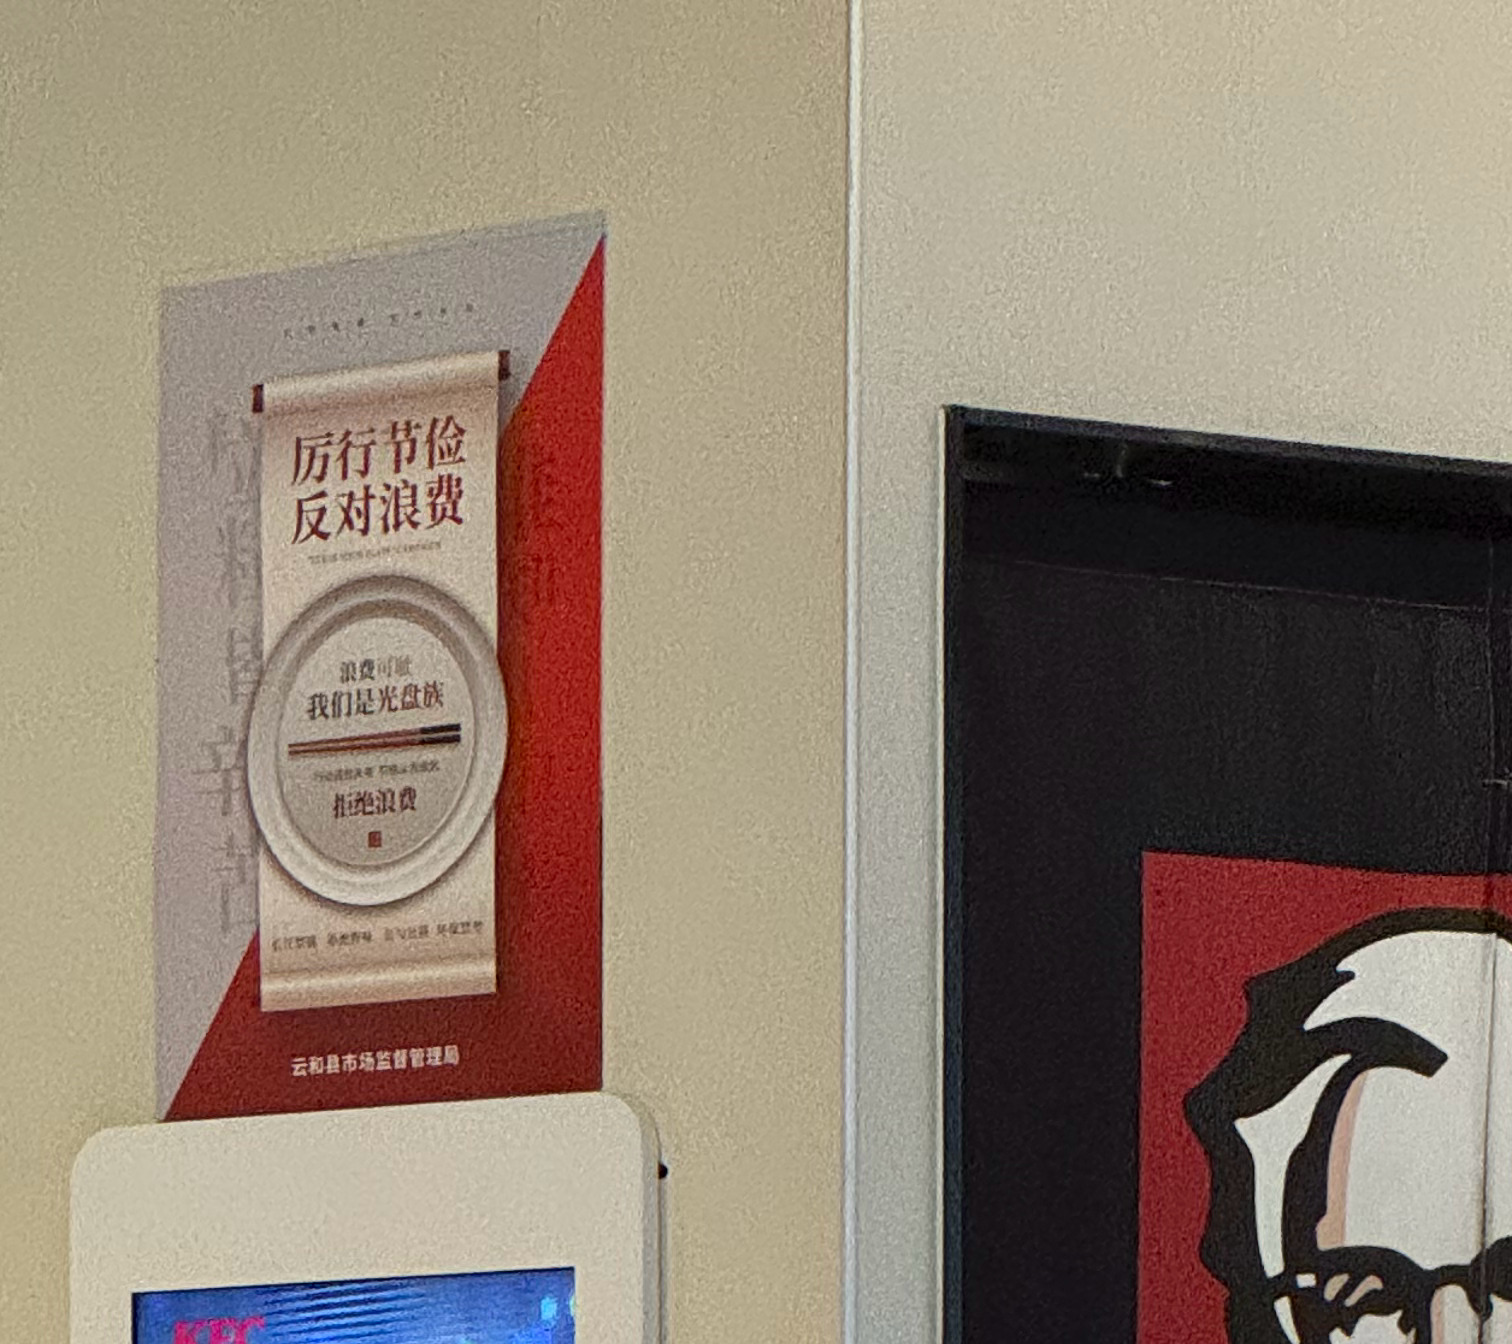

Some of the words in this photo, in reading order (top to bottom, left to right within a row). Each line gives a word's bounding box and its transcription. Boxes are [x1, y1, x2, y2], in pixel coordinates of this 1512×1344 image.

[291, 415, 467, 486] 厉行节俭
[291, 474, 464, 545] 反对浪费
[307, 680, 445, 720] 我们是光盘族
[333, 785, 418, 819] 拒绝浪费
[291, 1045, 461, 1077] 云和县市场监督管理局
